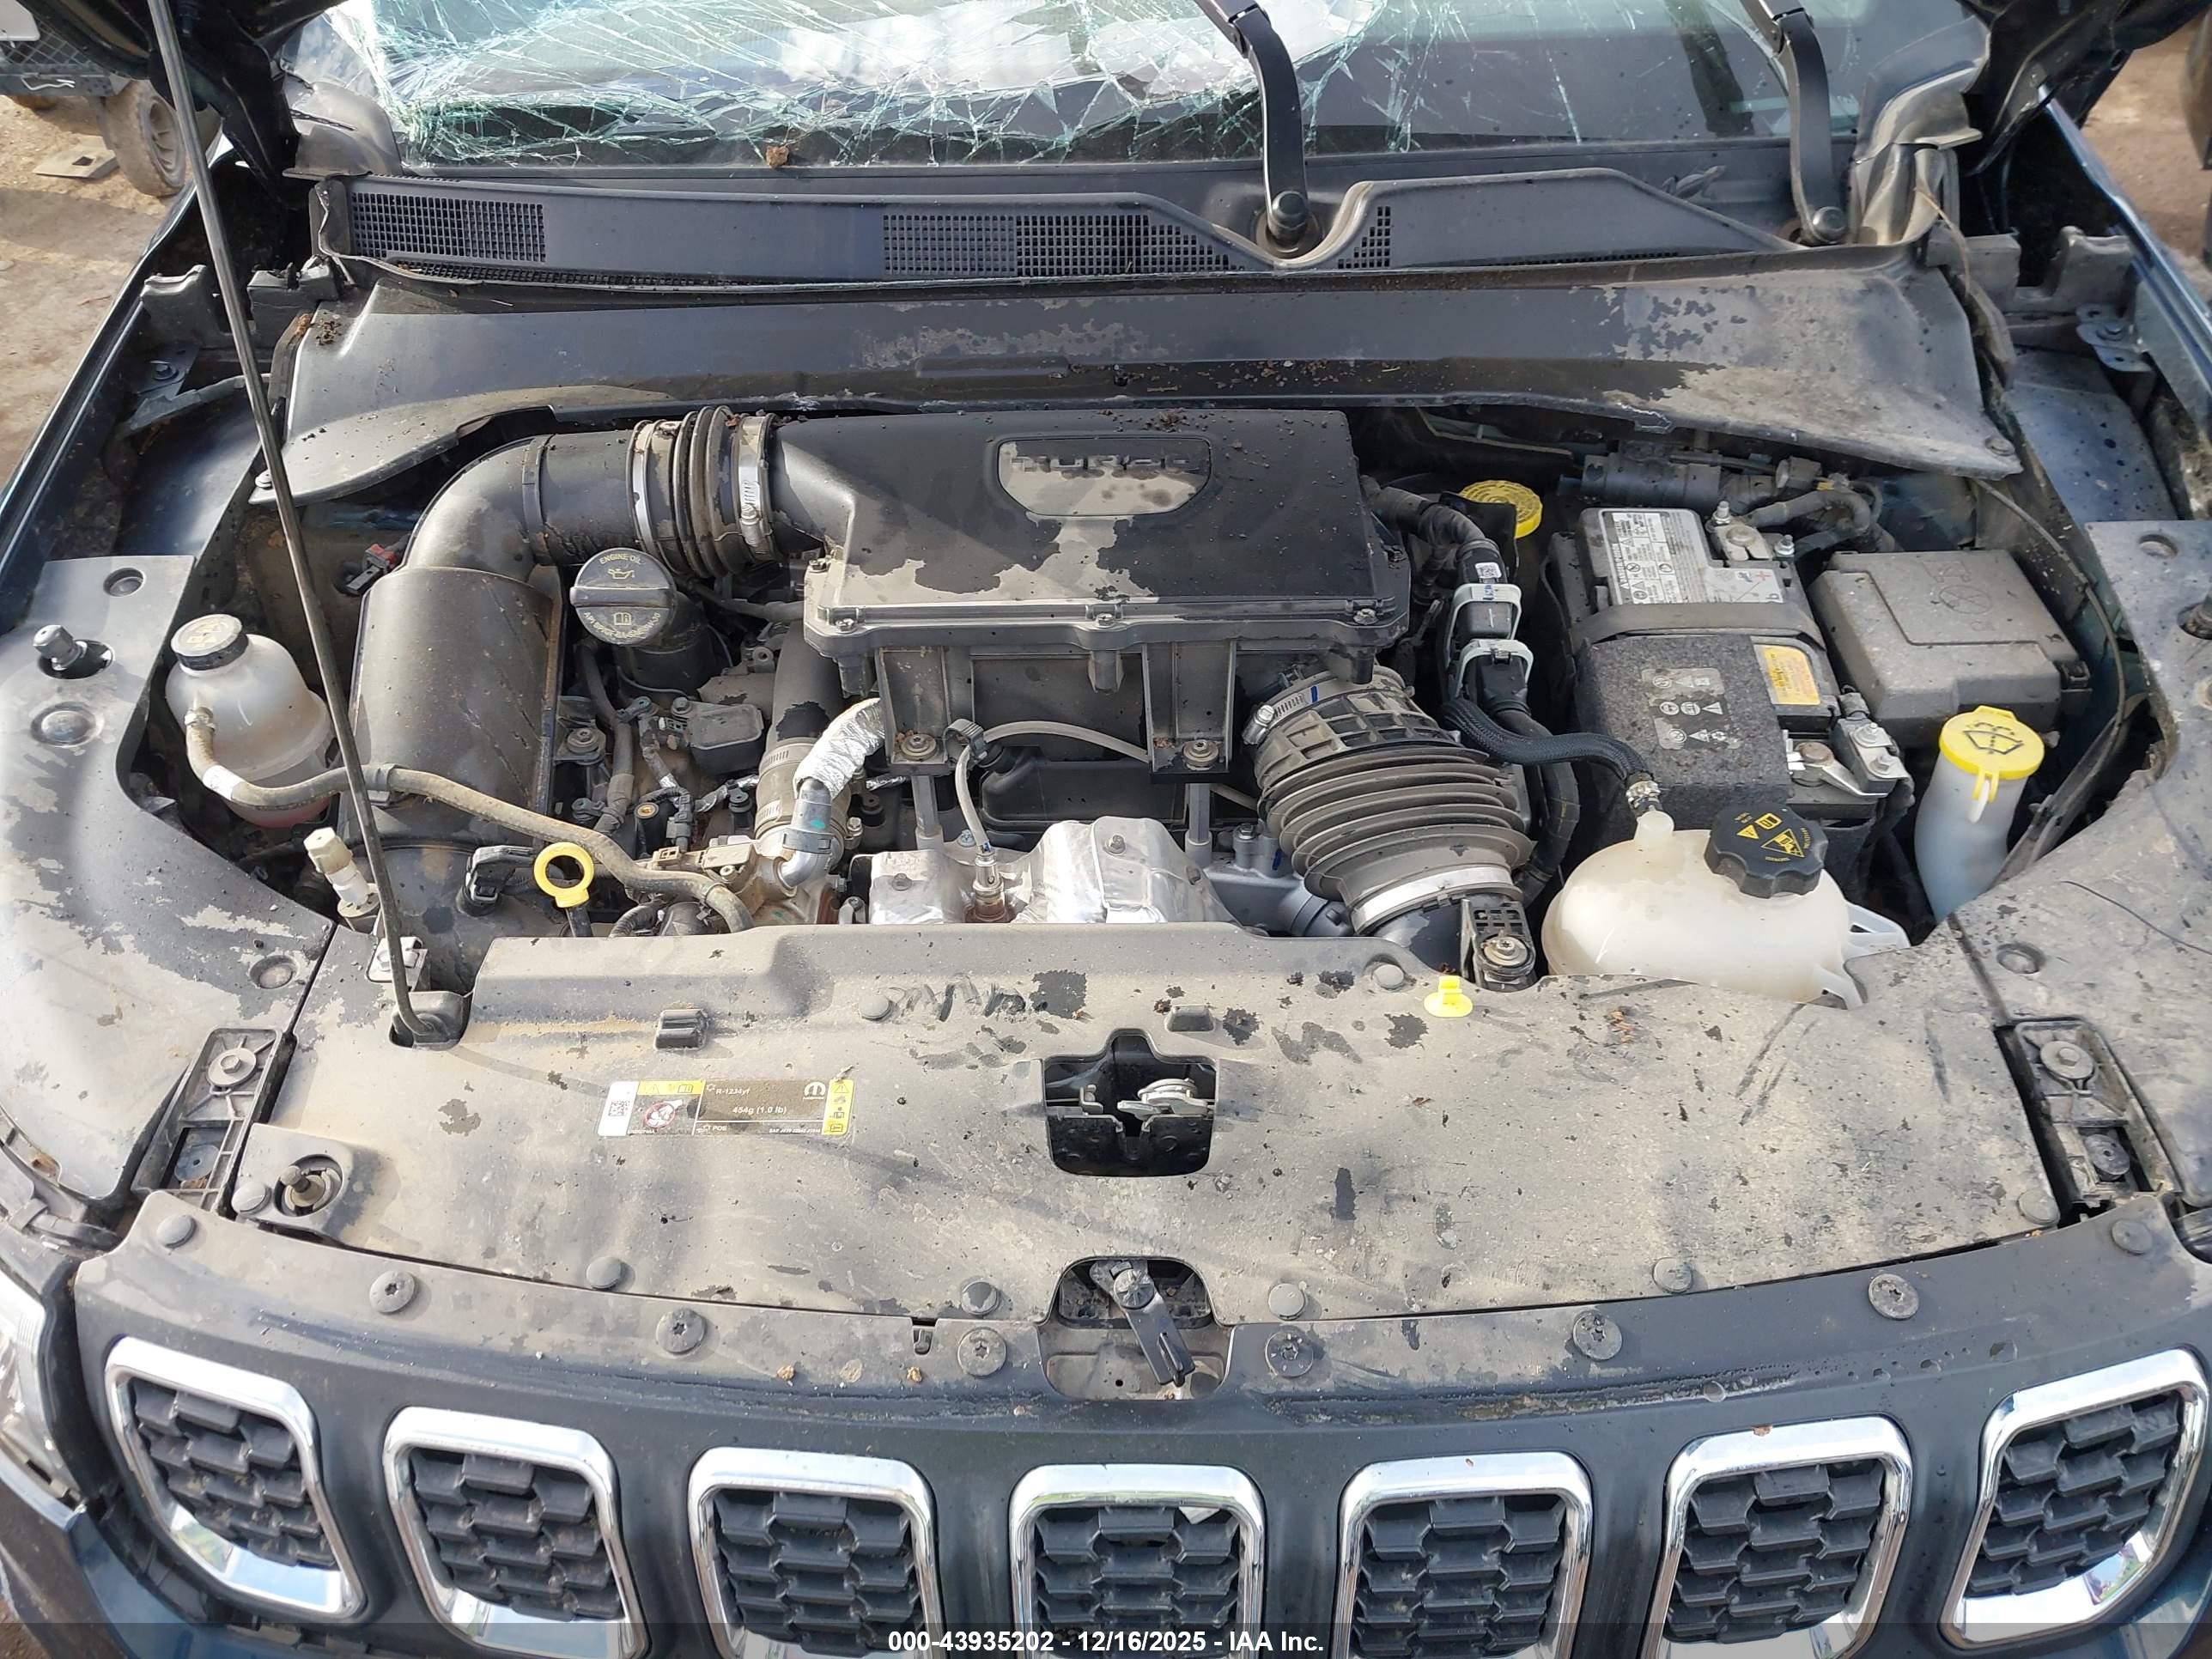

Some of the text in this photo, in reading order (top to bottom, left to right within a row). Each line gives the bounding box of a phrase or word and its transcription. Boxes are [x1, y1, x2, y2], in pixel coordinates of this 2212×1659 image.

[599, 554, 641, 564] ENGINE OIL
[584, 611, 597, 624] API
[715, 1086, 750, 1097] R-1234yf
[732, 1104, 787, 1115] 454g (1.0 lb)
